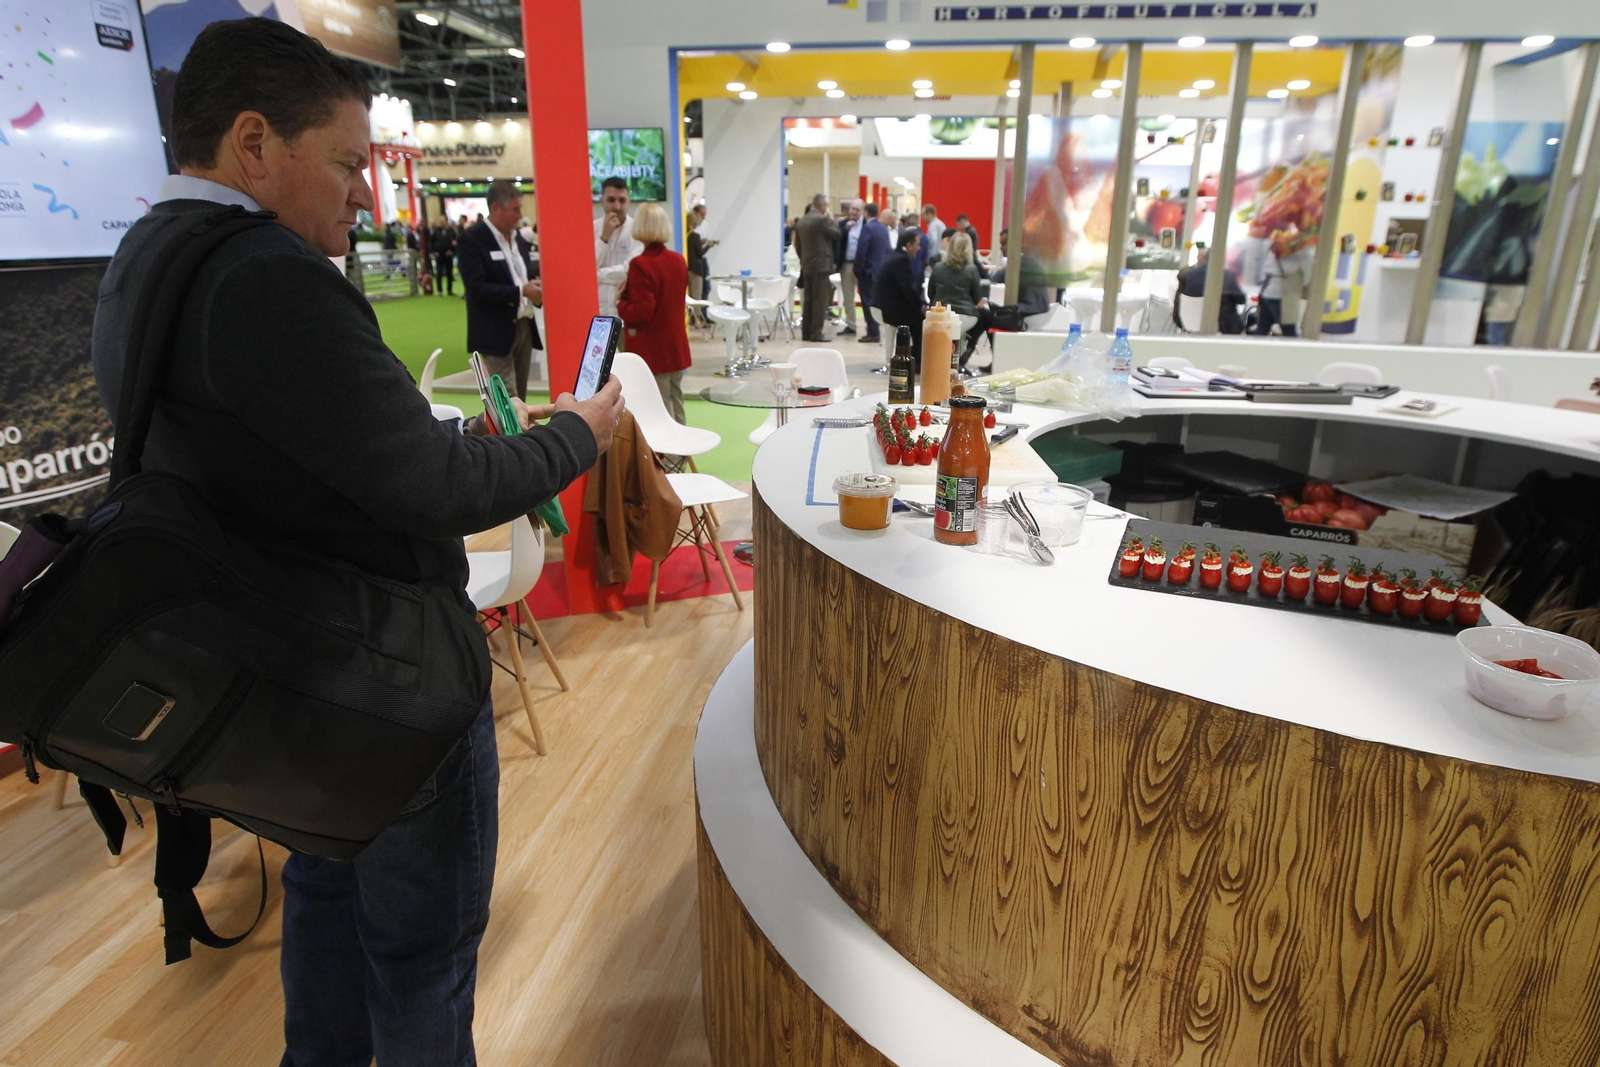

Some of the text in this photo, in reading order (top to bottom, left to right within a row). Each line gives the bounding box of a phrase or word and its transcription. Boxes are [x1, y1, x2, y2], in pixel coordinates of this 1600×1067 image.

[938, 3, 1314, 21] HORTOFRUTICOLA
[589, 165, 655, 178] ACEABILITY
[1290, 527, 1351, 543] CAPARRÓS
